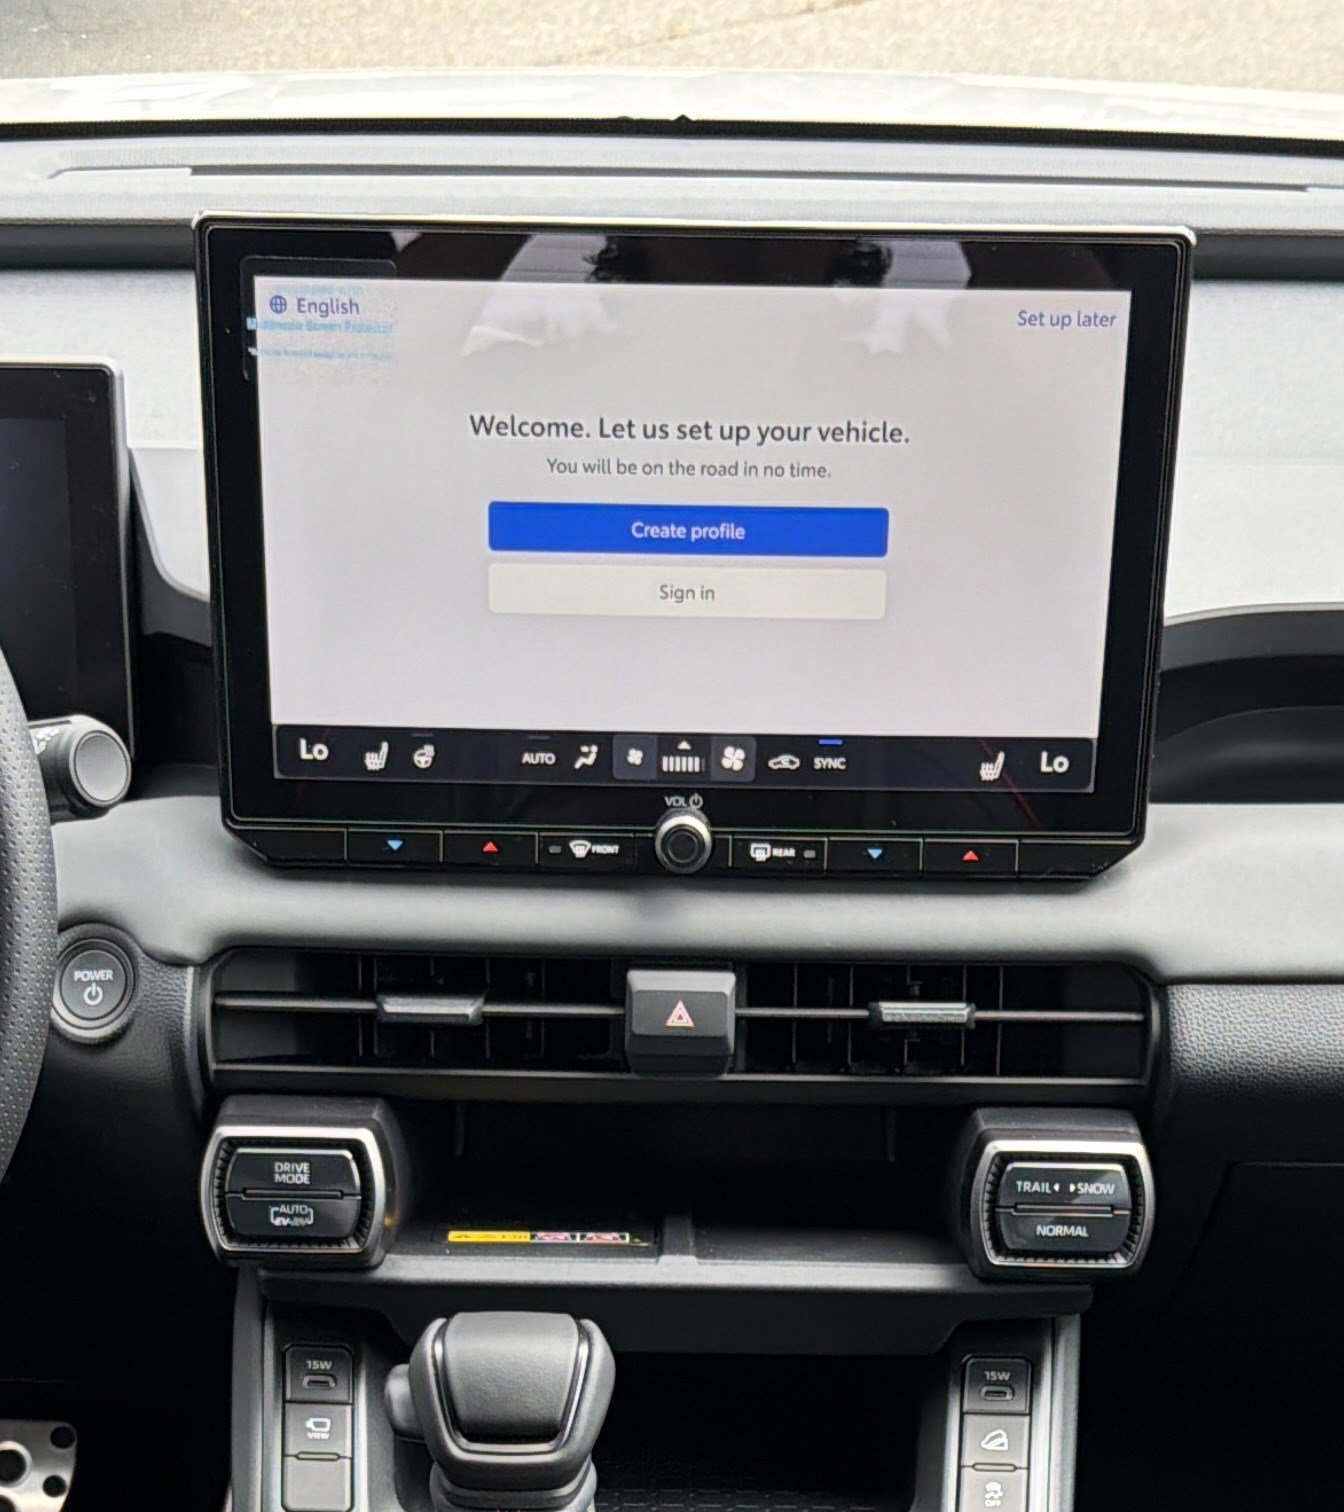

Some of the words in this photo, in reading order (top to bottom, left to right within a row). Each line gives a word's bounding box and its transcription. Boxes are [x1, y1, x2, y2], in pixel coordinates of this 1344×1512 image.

[297, 298, 360, 318] English
[1017, 310, 1045, 327] Set
[1050, 314, 1072, 330] up
[1077, 310, 1117, 328] later
[469, 415, 591, 439] Welcome.
[599, 416, 636, 440] Let
[642, 422, 670, 440] us
[676, 419, 712, 441] set
[719, 424, 750, 446] up
[756, 425, 812, 446] your
[818, 420, 910, 443] vehicle.
[546, 457, 578, 475] You
[581, 457, 612, 475] will
[616, 458, 638, 475] be
[641, 462, 664, 475] on
[669, 458, 695, 476] the
[700, 460, 738, 477] road
[743, 460, 759, 477] in
[763, 464, 785, 477] no
[789, 461, 832, 478] time.
[631, 521, 686, 539] Create
[690, 523, 746, 542] profile
[659, 584, 696, 603] Sign
[700, 585, 715, 601] in
[299, 739, 328, 761] Lo
[522, 751, 556, 765] AUTO
[814, 757, 846, 770] SYNC
[1040, 751, 1069, 773] Lo
[664, 796, 688, 807] VOL
[74, 969, 114, 981] POWER
[274, 1162, 311, 1173] DRIVE
[274, 1173, 311, 1184] MODE
[1016, 1180, 1052, 1193] TRAIL
[1077, 1182, 1115, 1195] SNOW
[279, 1204, 308, 1214] AUTO
[1036, 1225, 1089, 1237] NORMAL
[307, 1359, 333, 1370] 15W
[984, 1370, 1011, 1381] 15W
